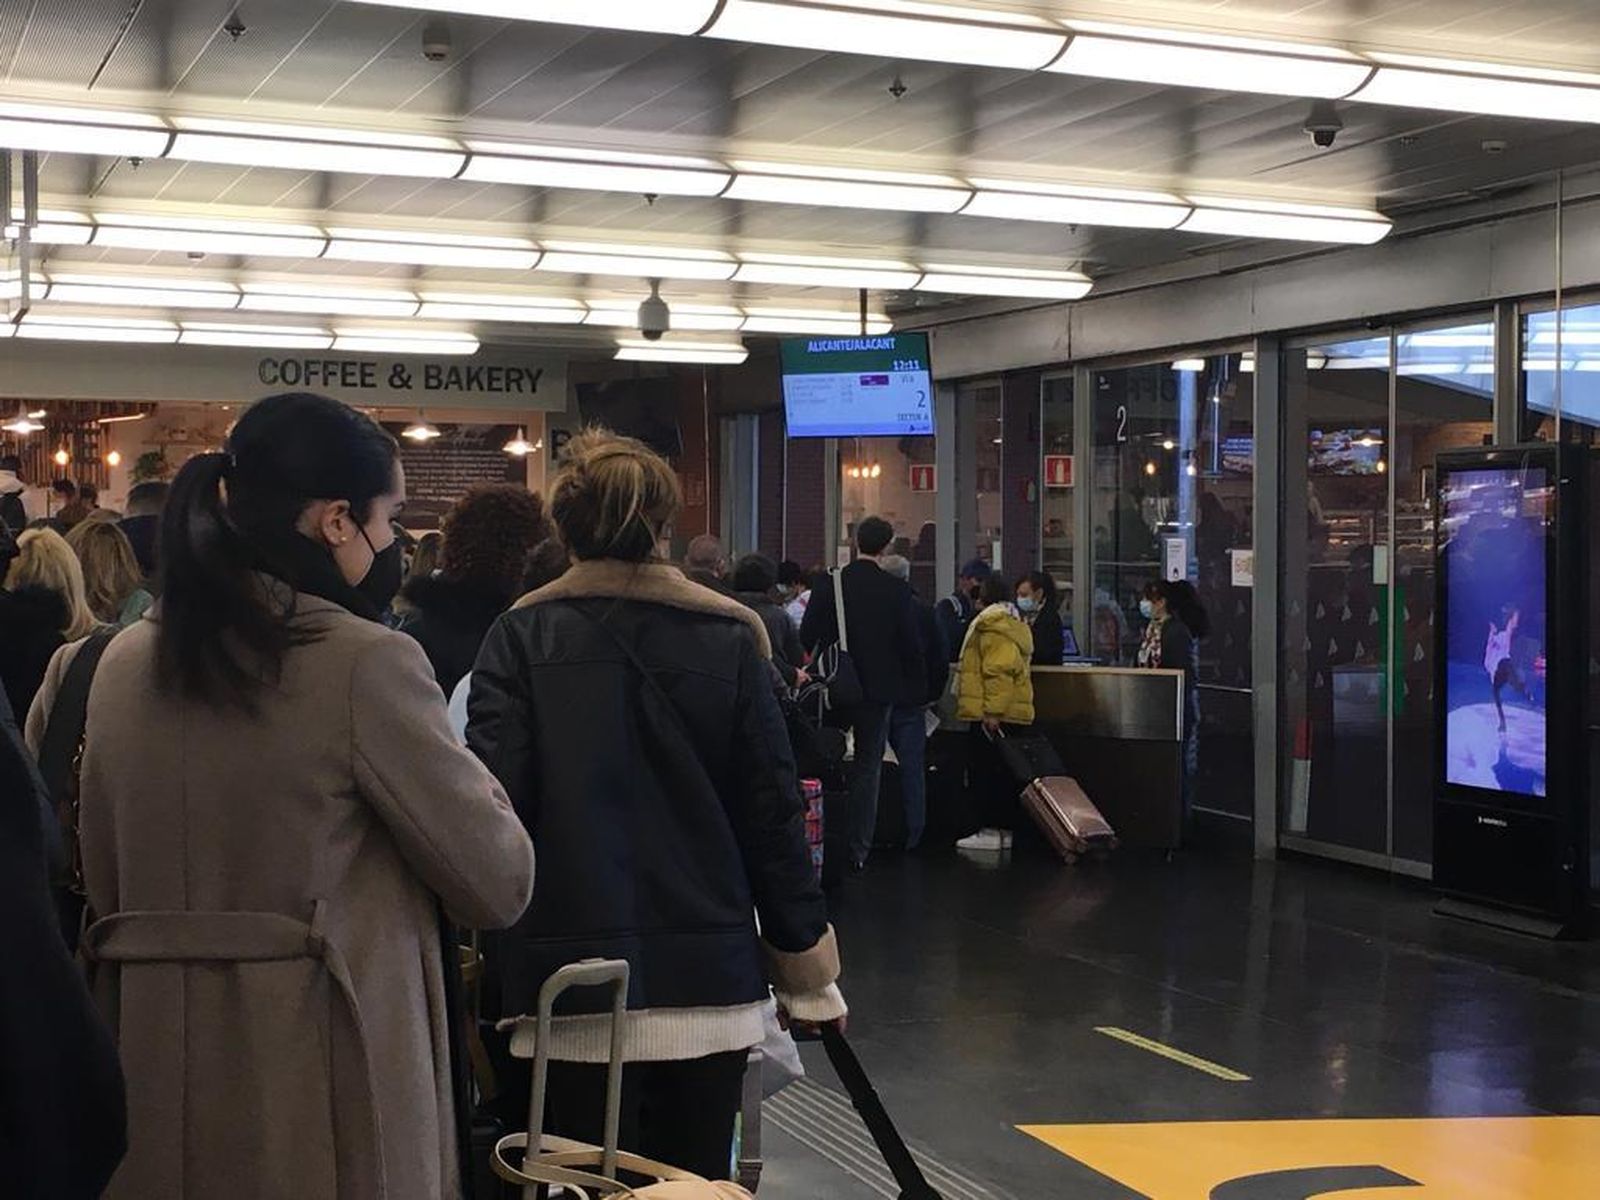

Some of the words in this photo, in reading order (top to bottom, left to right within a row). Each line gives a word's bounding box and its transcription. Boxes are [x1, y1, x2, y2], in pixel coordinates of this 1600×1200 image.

[258, 357, 378, 389] COFFEE
[388, 363, 412, 390] &
[424, 364, 544, 394] BAKERY
[916, 390, 926, 408] 2
[1117, 405, 1127, 441] 2
